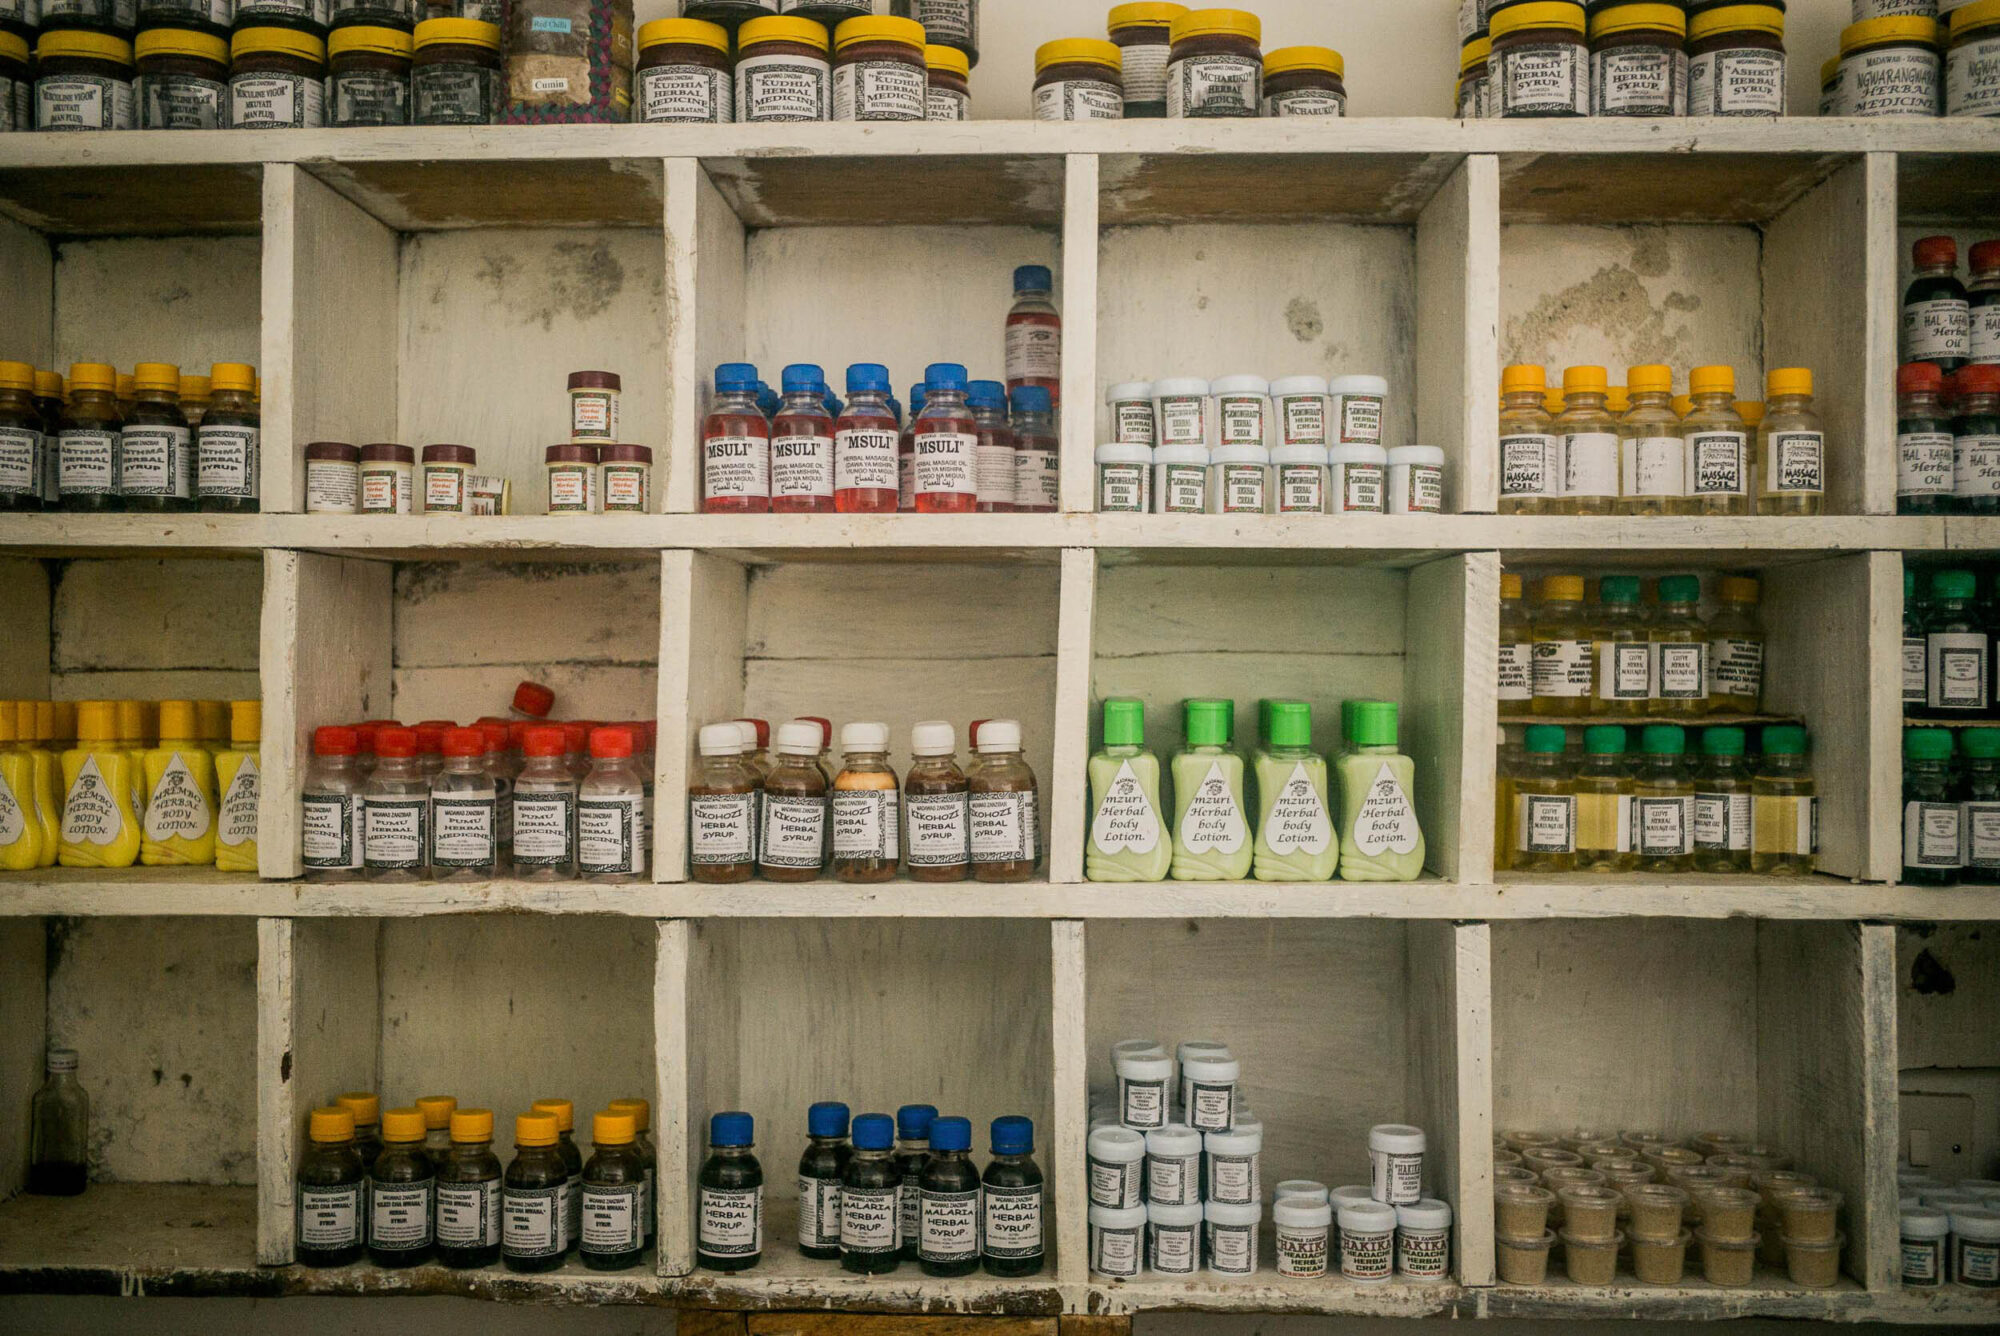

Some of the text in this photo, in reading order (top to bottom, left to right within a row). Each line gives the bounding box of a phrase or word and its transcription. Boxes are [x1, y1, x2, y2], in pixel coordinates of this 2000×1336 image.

[1514, 71, 1564, 81] HERBAL
[1613, 74, 1663, 82] HERBAL
[535, 80, 564, 89] Cumin
[1518, 80, 1559, 90] SYRUP.
[1730, 77, 1776, 87] HERBAL
[762, 88, 811, 96] HERBAL
[876, 85, 919, 96] HERBAL
[1208, 86, 1242, 94] HERBAL
[1617, 83, 1659, 92] SYRUP.
[1861, 85, 1930, 98] HERBAL
[648, 97, 708, 108] MEDICINE
[755, 96, 816, 107] MEDICINE
[868, 94, 923, 107] MEDICINE
[1203, 97, 1245, 106] MEDICINE
[1946, 339, 1963, 348] Oil
[844, 436, 893, 449] "MSULI"
[917, 441, 964, 454] "MSULI"
[707, 444, 752, 458] "MSULI"
[774, 444, 820, 458] "MSULI"
[1506, 472, 1540, 483] MASSAGE
[1701, 471, 1735, 481] MASSAGE
[1785, 469, 1818, 479] MASSAGE
[1925, 475, 1944, 484] Oil
[1106, 794, 1143, 803] mzuri
[1195, 795, 1230, 804] mzuri
[1279, 796, 1316, 805] mzuri
[1367, 796, 1403, 806] mzuri
[154, 800, 200, 811] HERBAL
[67, 805, 110, 817] HERBAL
[162, 810, 191, 819] BODY
[695, 809, 743, 820] KIKOHOZI
[774, 809, 821, 823] KIKOHOZI
[912, 808, 959, 820] KIKOHOZI
[1101, 806, 1146, 816] Herbal
[1190, 807, 1234, 817] Herbal
[1275, 808, 1320, 818] Herbal
[1363, 807, 1406, 818] Herbal
[73, 815, 102, 824] BODY
[836, 818, 868, 826] HERBAL
[69, 826, 108, 834] LOTION.
[156, 821, 198, 830] LOTION.
[781, 824, 818, 833] HERBAL
[918, 822, 956, 830] HERBAL
[1110, 819, 1138, 831] body
[1198, 820, 1226, 831] body
[1282, 820, 1312, 832] body
[1372, 821, 1400, 832] body
[1277, 835, 1318, 843] Lotion.
[1366, 834, 1406, 843] Lotion.
[704, 1200, 752, 1208] MALARIA
[844, 1202, 891, 1210] MALARIA
[706, 1210, 747, 1218] HERBAL
[845, 1211, 886, 1220] HERBAL
[928, 1218, 970, 1226] HERBAL
